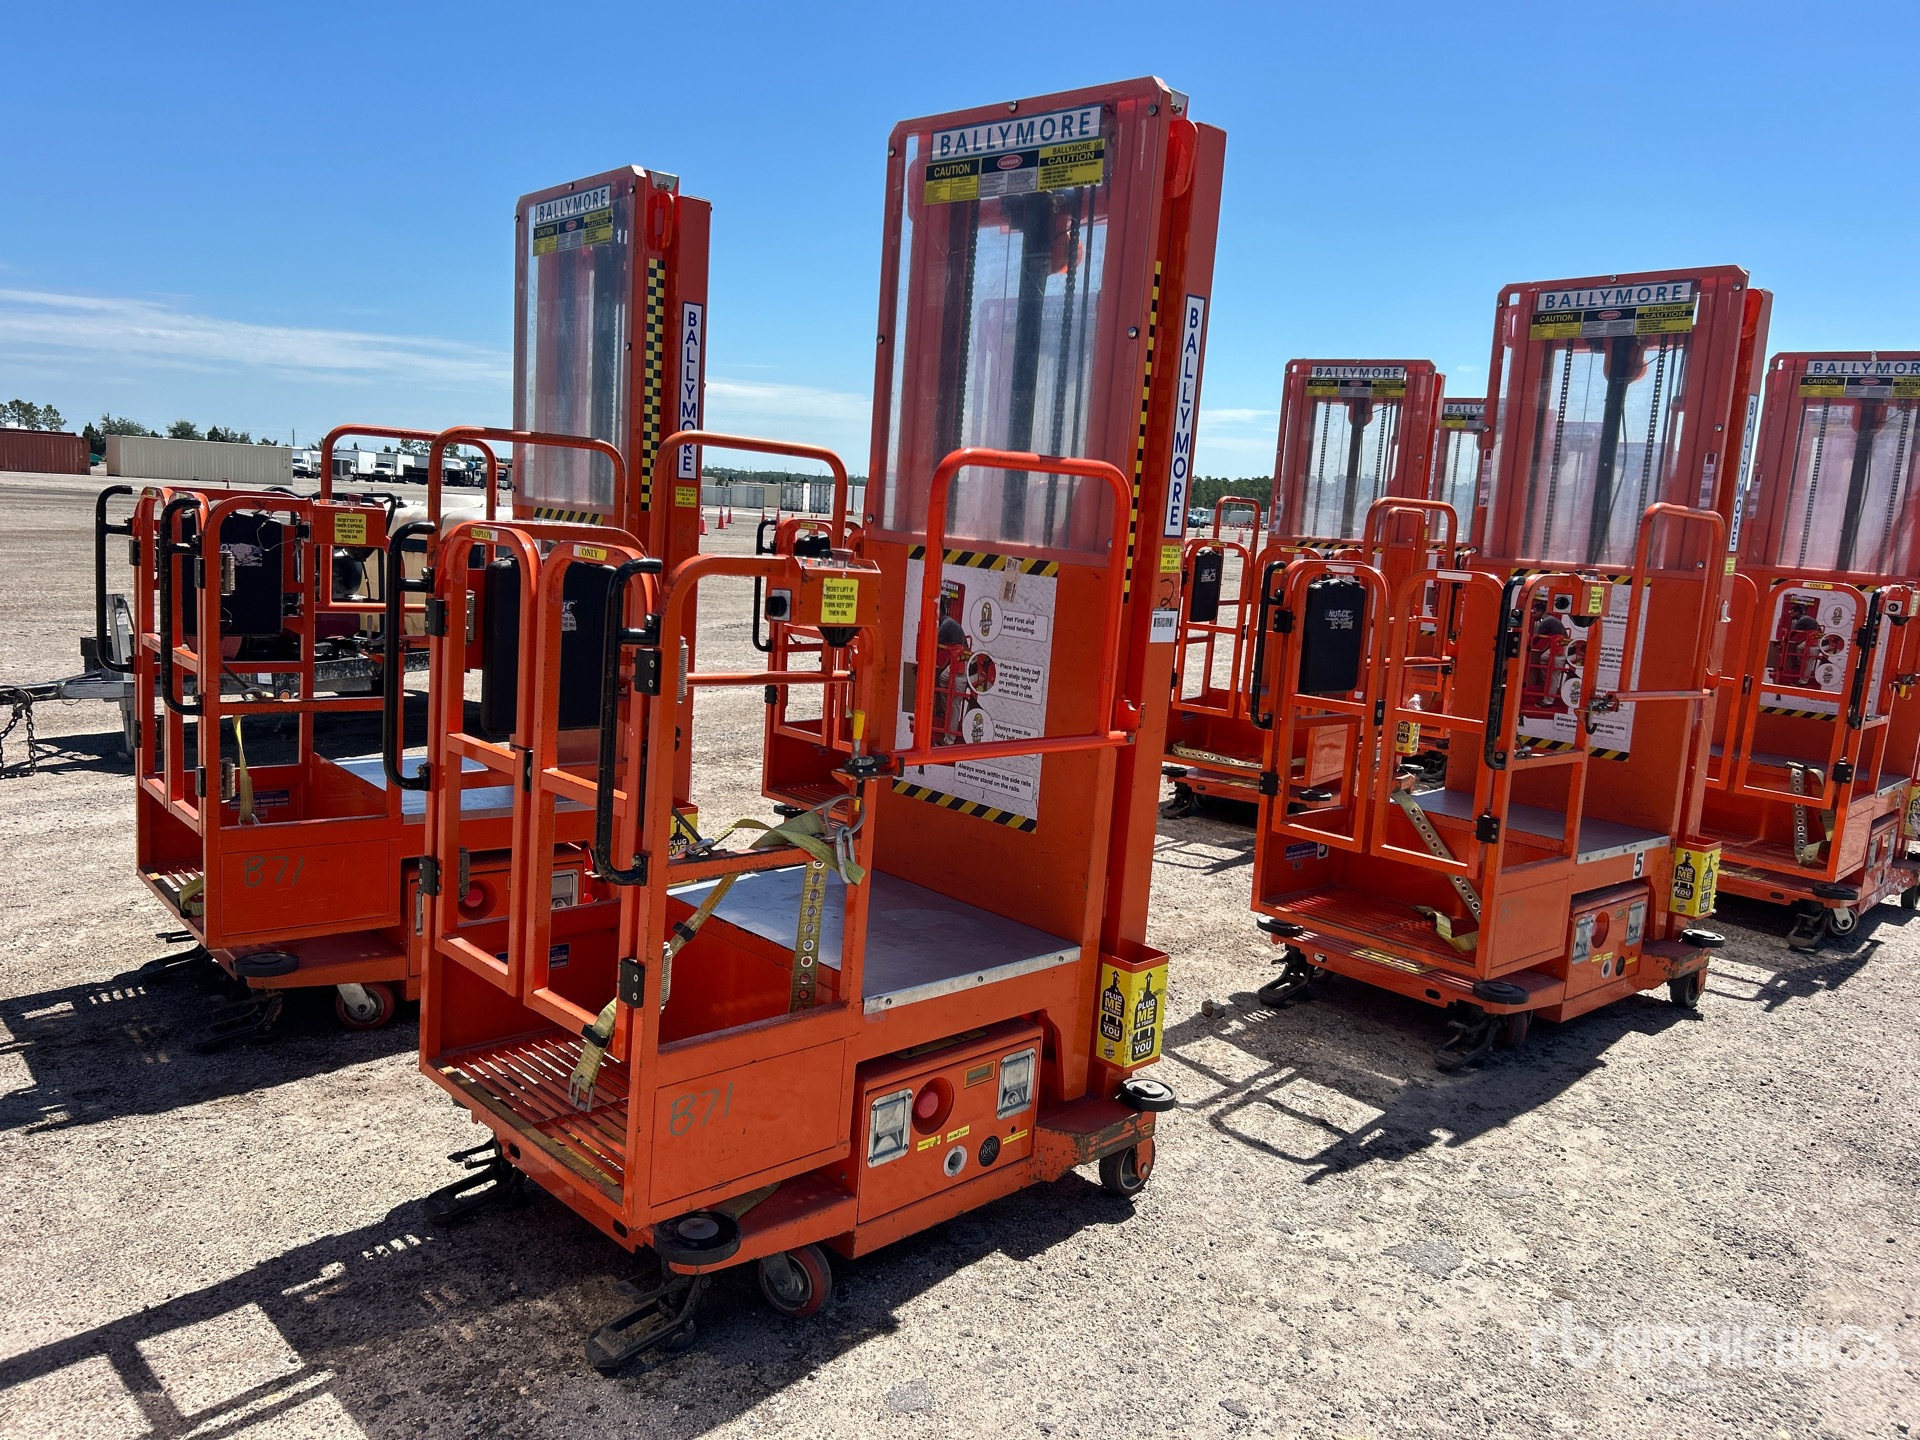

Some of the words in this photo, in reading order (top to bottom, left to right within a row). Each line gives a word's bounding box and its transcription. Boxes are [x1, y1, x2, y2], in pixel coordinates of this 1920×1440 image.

[940, 111, 1091, 157] BALLYMORE
[1052, 143, 1091, 155] BALLYMORE
[1048, 152, 1095, 165] CAUTION
[934, 163, 971, 178] CAUTION
[540, 189, 606, 221] BALLYMORE
[588, 219, 608, 228] CAUTION
[536, 227, 554, 237] CAUTION
[1545, 285, 1682, 309] BALLYMORE
[1643, 311, 1686, 319] CAUTION
[1648, 305, 1682, 313] BALLYMORE
[1539, 314, 1573, 323] CAUTION
[1316, 367, 1400, 378] BALLYMORE
[681, 311, 698, 472] BALLYMORE
[1448, 405, 1485, 413] BALLY
[1169, 306, 1199, 527] BALLYMORE
[1731, 401, 1755, 546] BALLYMORE
[581, 547, 599, 558] ONLY
[1004, 615, 1013, 623] Feet
[1000, 662, 1012, 670] Place
[1020, 666, 1031, 675] body
[1032, 668, 1041, 676] belt
[1005, 680, 1019, 688] yellow
[995, 723, 1011, 733] Always
[995, 732, 1006, 740] body
[958, 763, 974, 772] Always
[987, 771, 1001, 779] within
[1010, 776, 1020, 784] side
[1020, 780, 1031, 788] rails
[668, 838, 687, 846] PLUG
[1634, 851, 1644, 877] 5
[1677, 865, 1694, 873] PLUG
[1677, 870, 1693, 880] ME
[1675, 888, 1691, 896] YOU
[1105, 990, 1123, 1003] PLUG
[1104, 997, 1122, 1012] ME
[1137, 998, 1156, 1011] PLUG
[1136, 1006, 1155, 1024] ME
[1103, 1024, 1120, 1037] YOU
[1134, 1040, 1152, 1054] YOU
